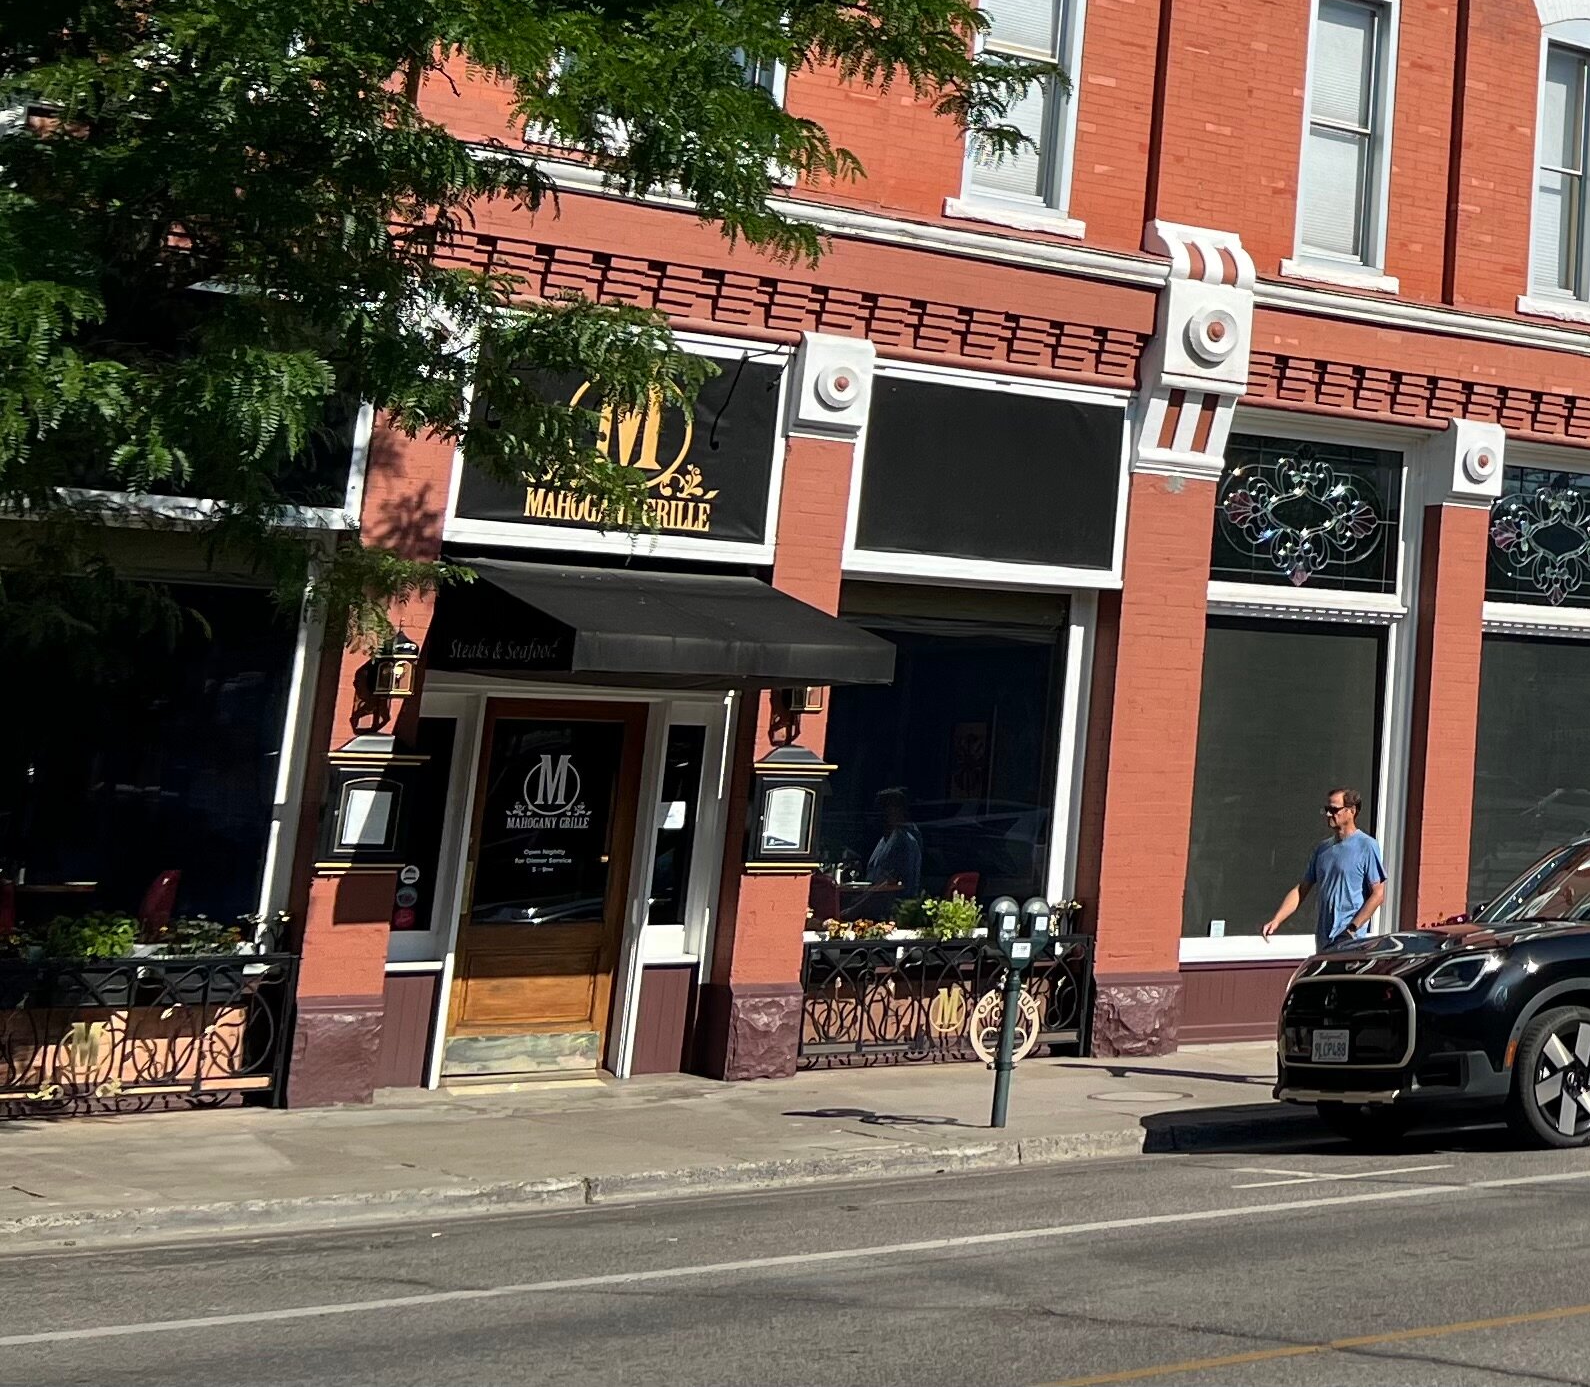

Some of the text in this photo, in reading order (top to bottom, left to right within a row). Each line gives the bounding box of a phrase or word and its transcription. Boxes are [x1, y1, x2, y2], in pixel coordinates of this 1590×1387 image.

[523, 486, 711, 532] MAHOG GRILLE
[449, 638, 489, 659] Steaks
[534, 754, 572, 805] M
[506, 817, 590, 829] MAHOGANY GRILLE
[936, 987, 962, 1028] M
[71, 1021, 109, 1067] M
